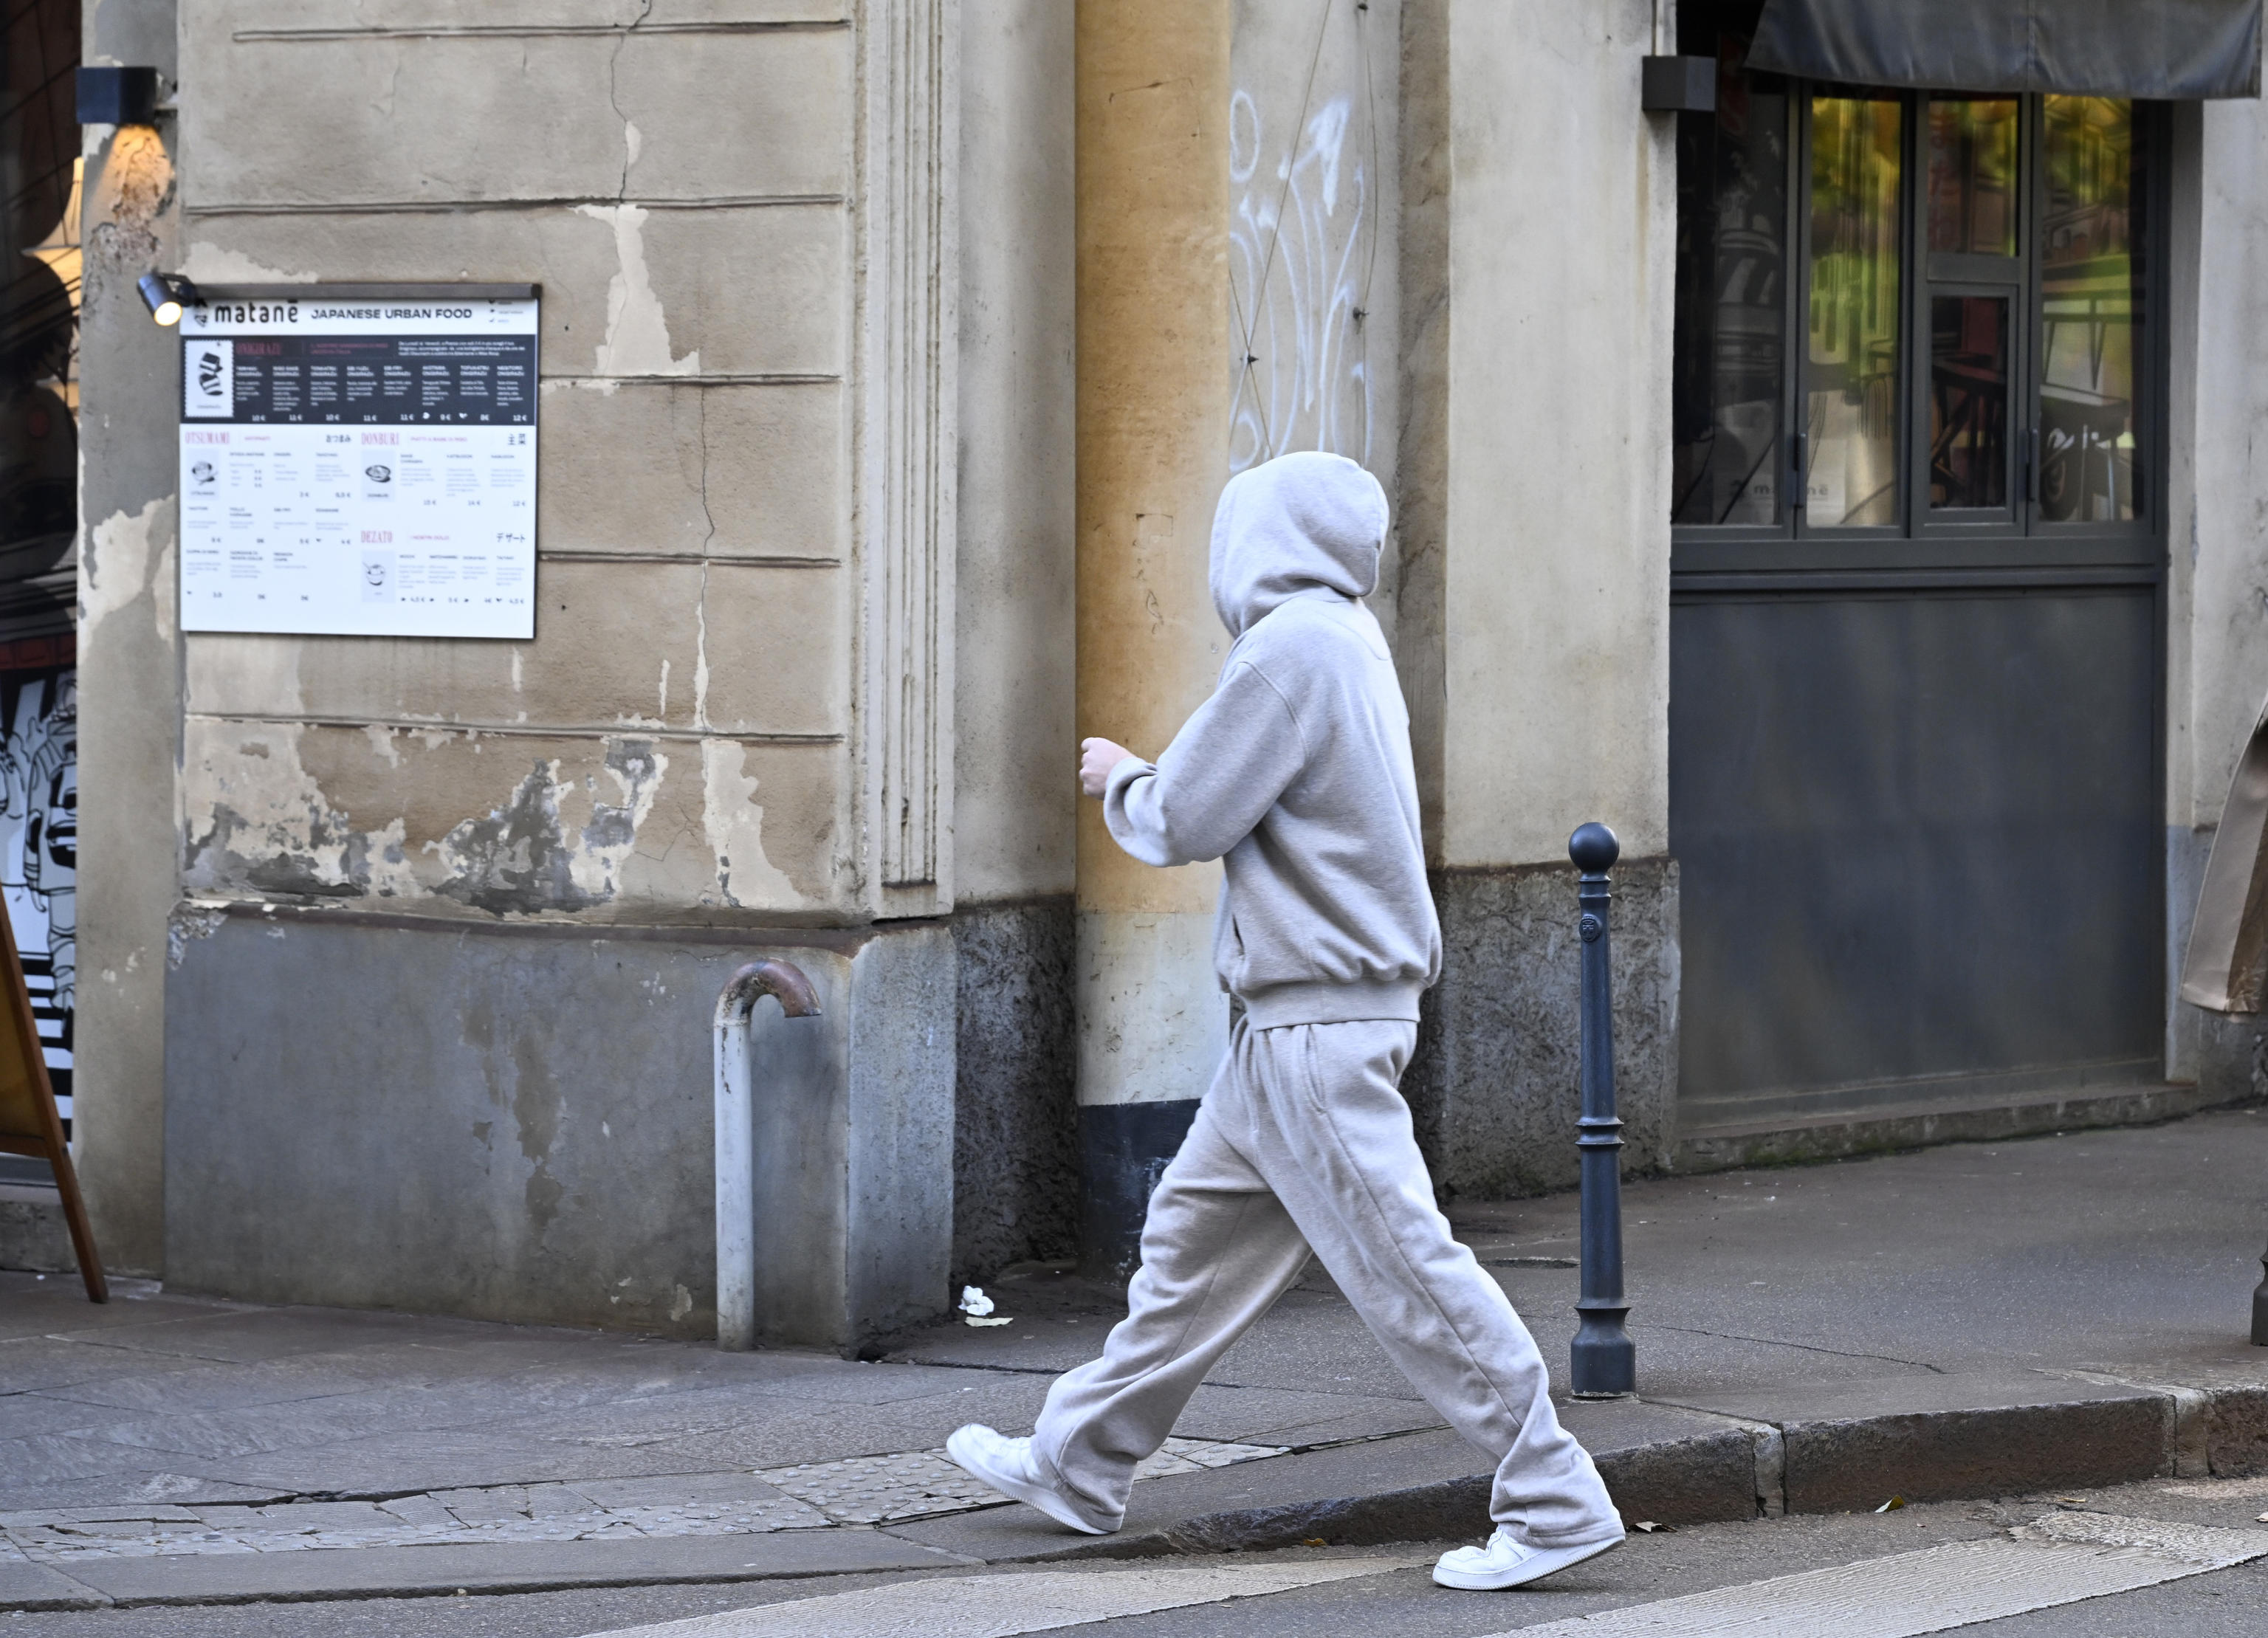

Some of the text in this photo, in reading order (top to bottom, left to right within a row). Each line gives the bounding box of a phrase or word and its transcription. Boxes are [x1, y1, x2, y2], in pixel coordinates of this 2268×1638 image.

[310, 308, 472, 320] JAPANESE URBAN FOOD
[185, 432, 230, 444] OTSUMAMI
[361, 433, 399, 445] DONBURI
[360, 530, 393, 543] DEZATO
